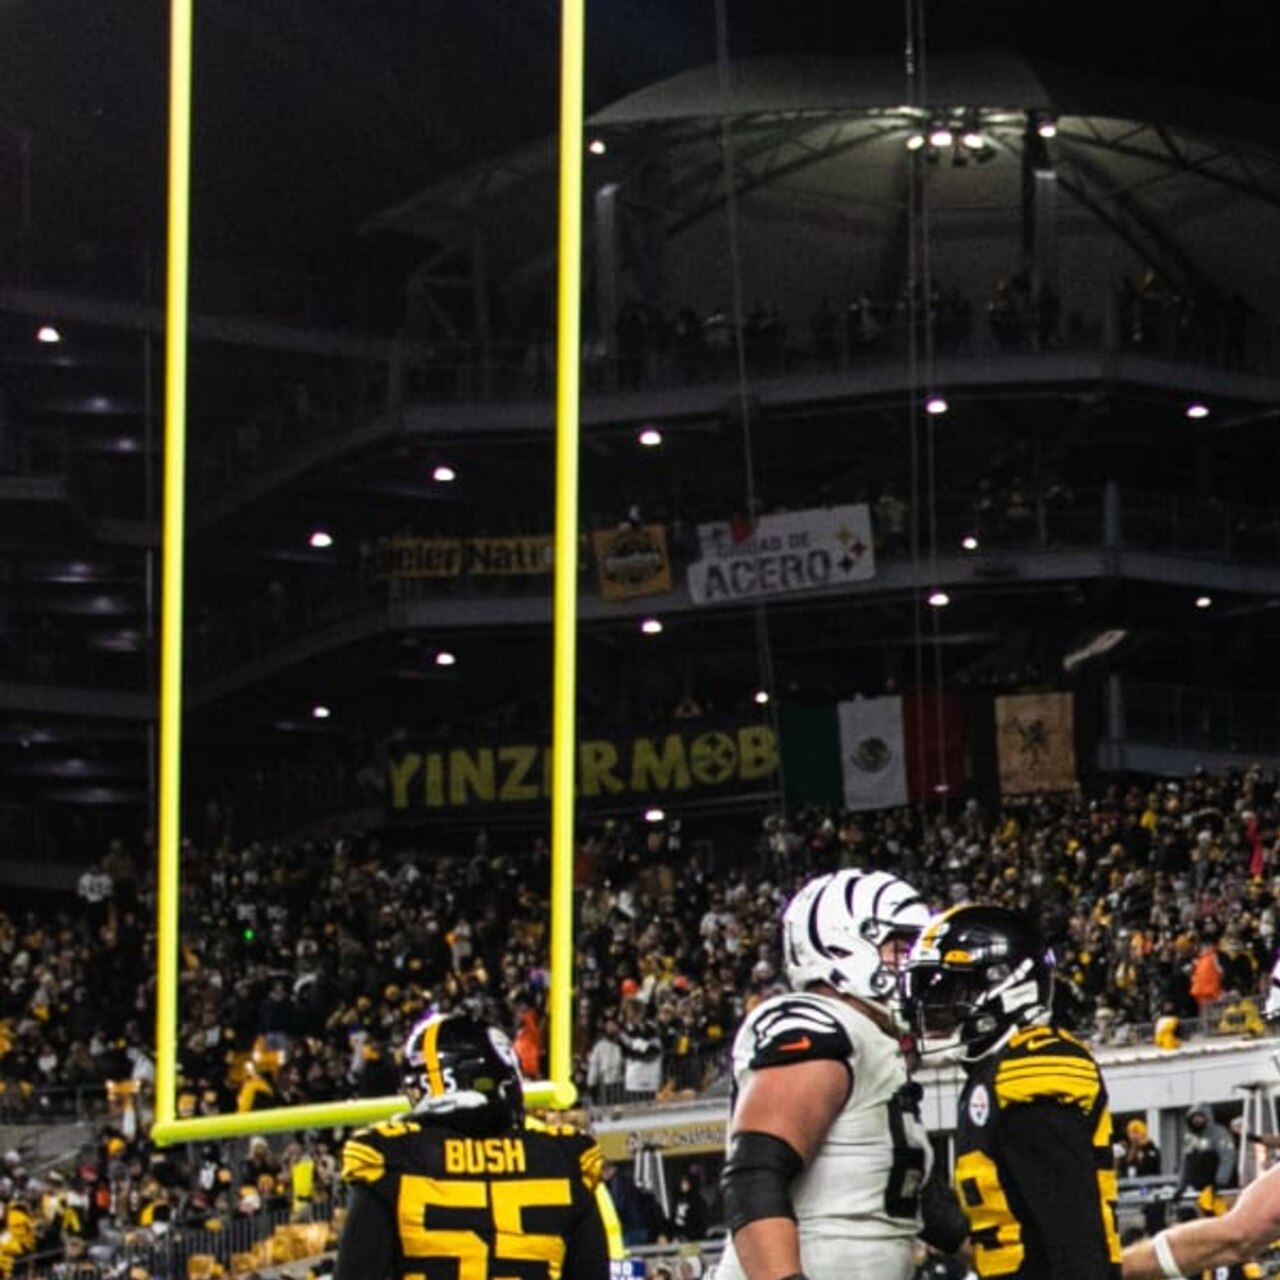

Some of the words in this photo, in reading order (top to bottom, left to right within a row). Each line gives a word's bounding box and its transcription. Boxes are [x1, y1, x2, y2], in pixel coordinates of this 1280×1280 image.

[706, 549, 831, 598] ACERO
[390, 738, 625, 808] YINZR
[631, 725, 780, 792] MOB
[445, 1138, 526, 1174] BUSH
